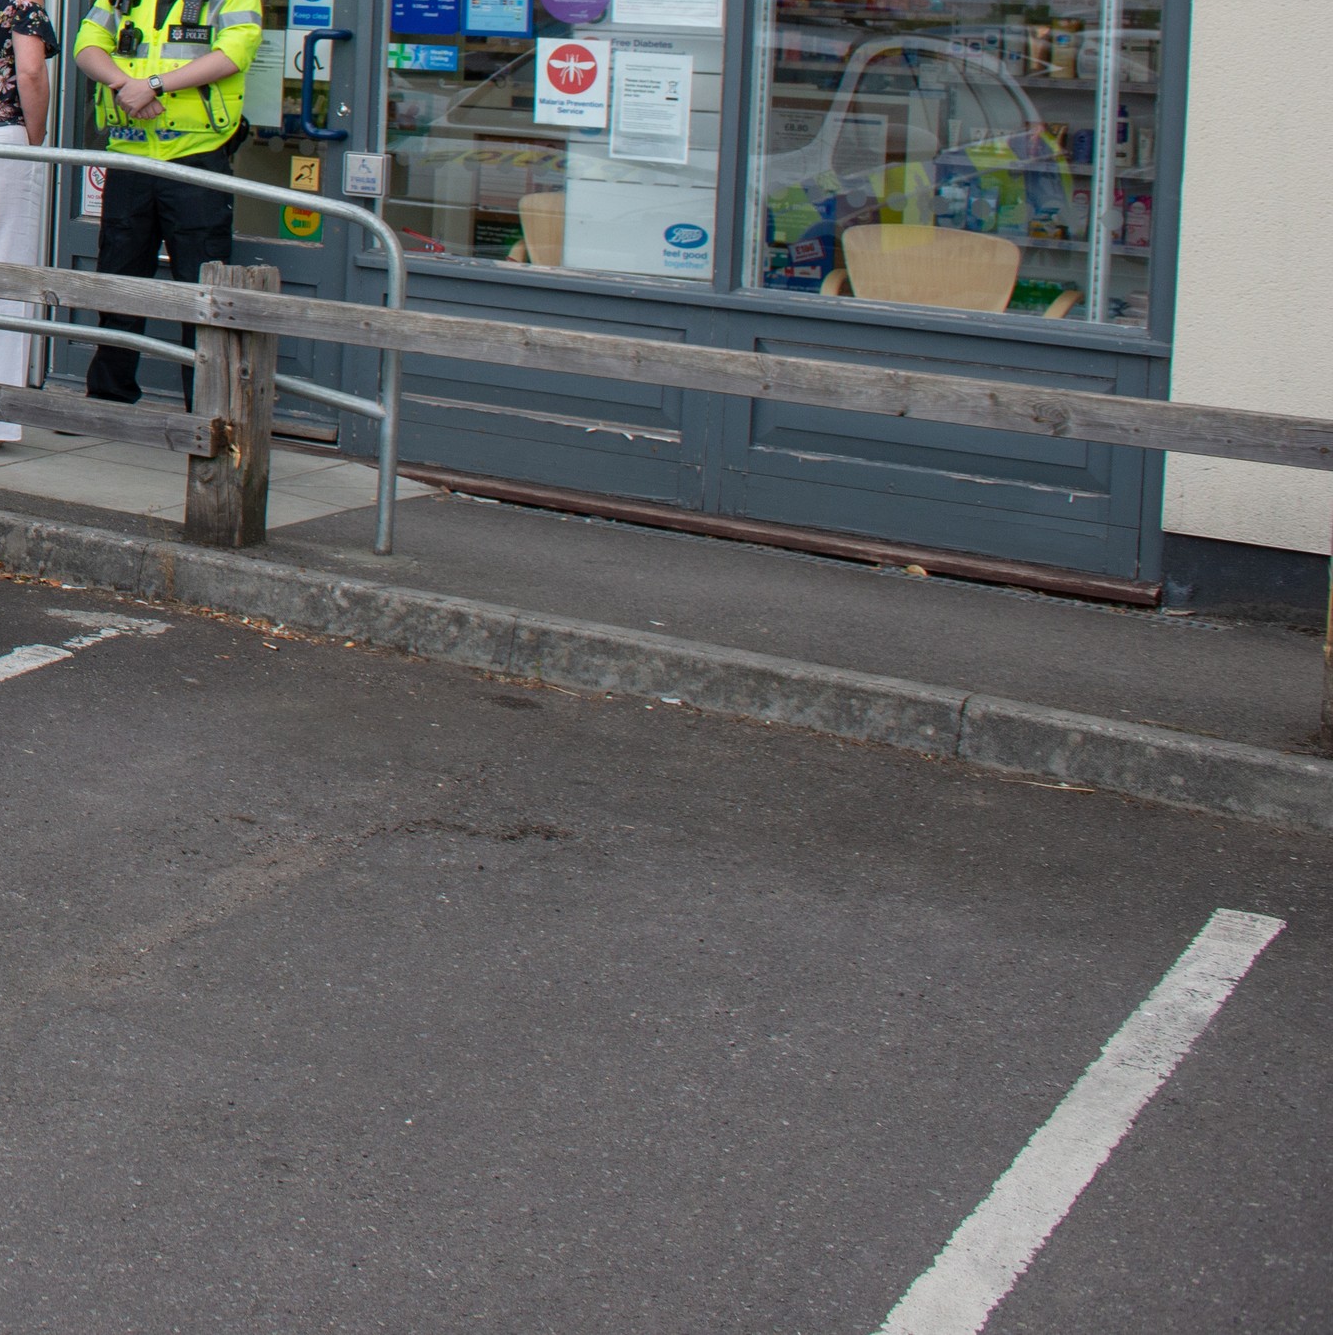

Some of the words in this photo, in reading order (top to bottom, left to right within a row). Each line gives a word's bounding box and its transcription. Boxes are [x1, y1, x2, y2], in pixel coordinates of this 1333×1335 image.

[294, 12, 311, 20] Keep
[186, 32, 208, 40] POLICE
[611, 39, 631, 47] Free
[633, 40, 673, 49] Diabetes
[539, 98, 565, 106] Malaria
[566, 99, 604, 108] Prevention
[556, 107, 585, 115] Service
[663, 249, 681, 257] feel
[682, 251, 708, 260] good
